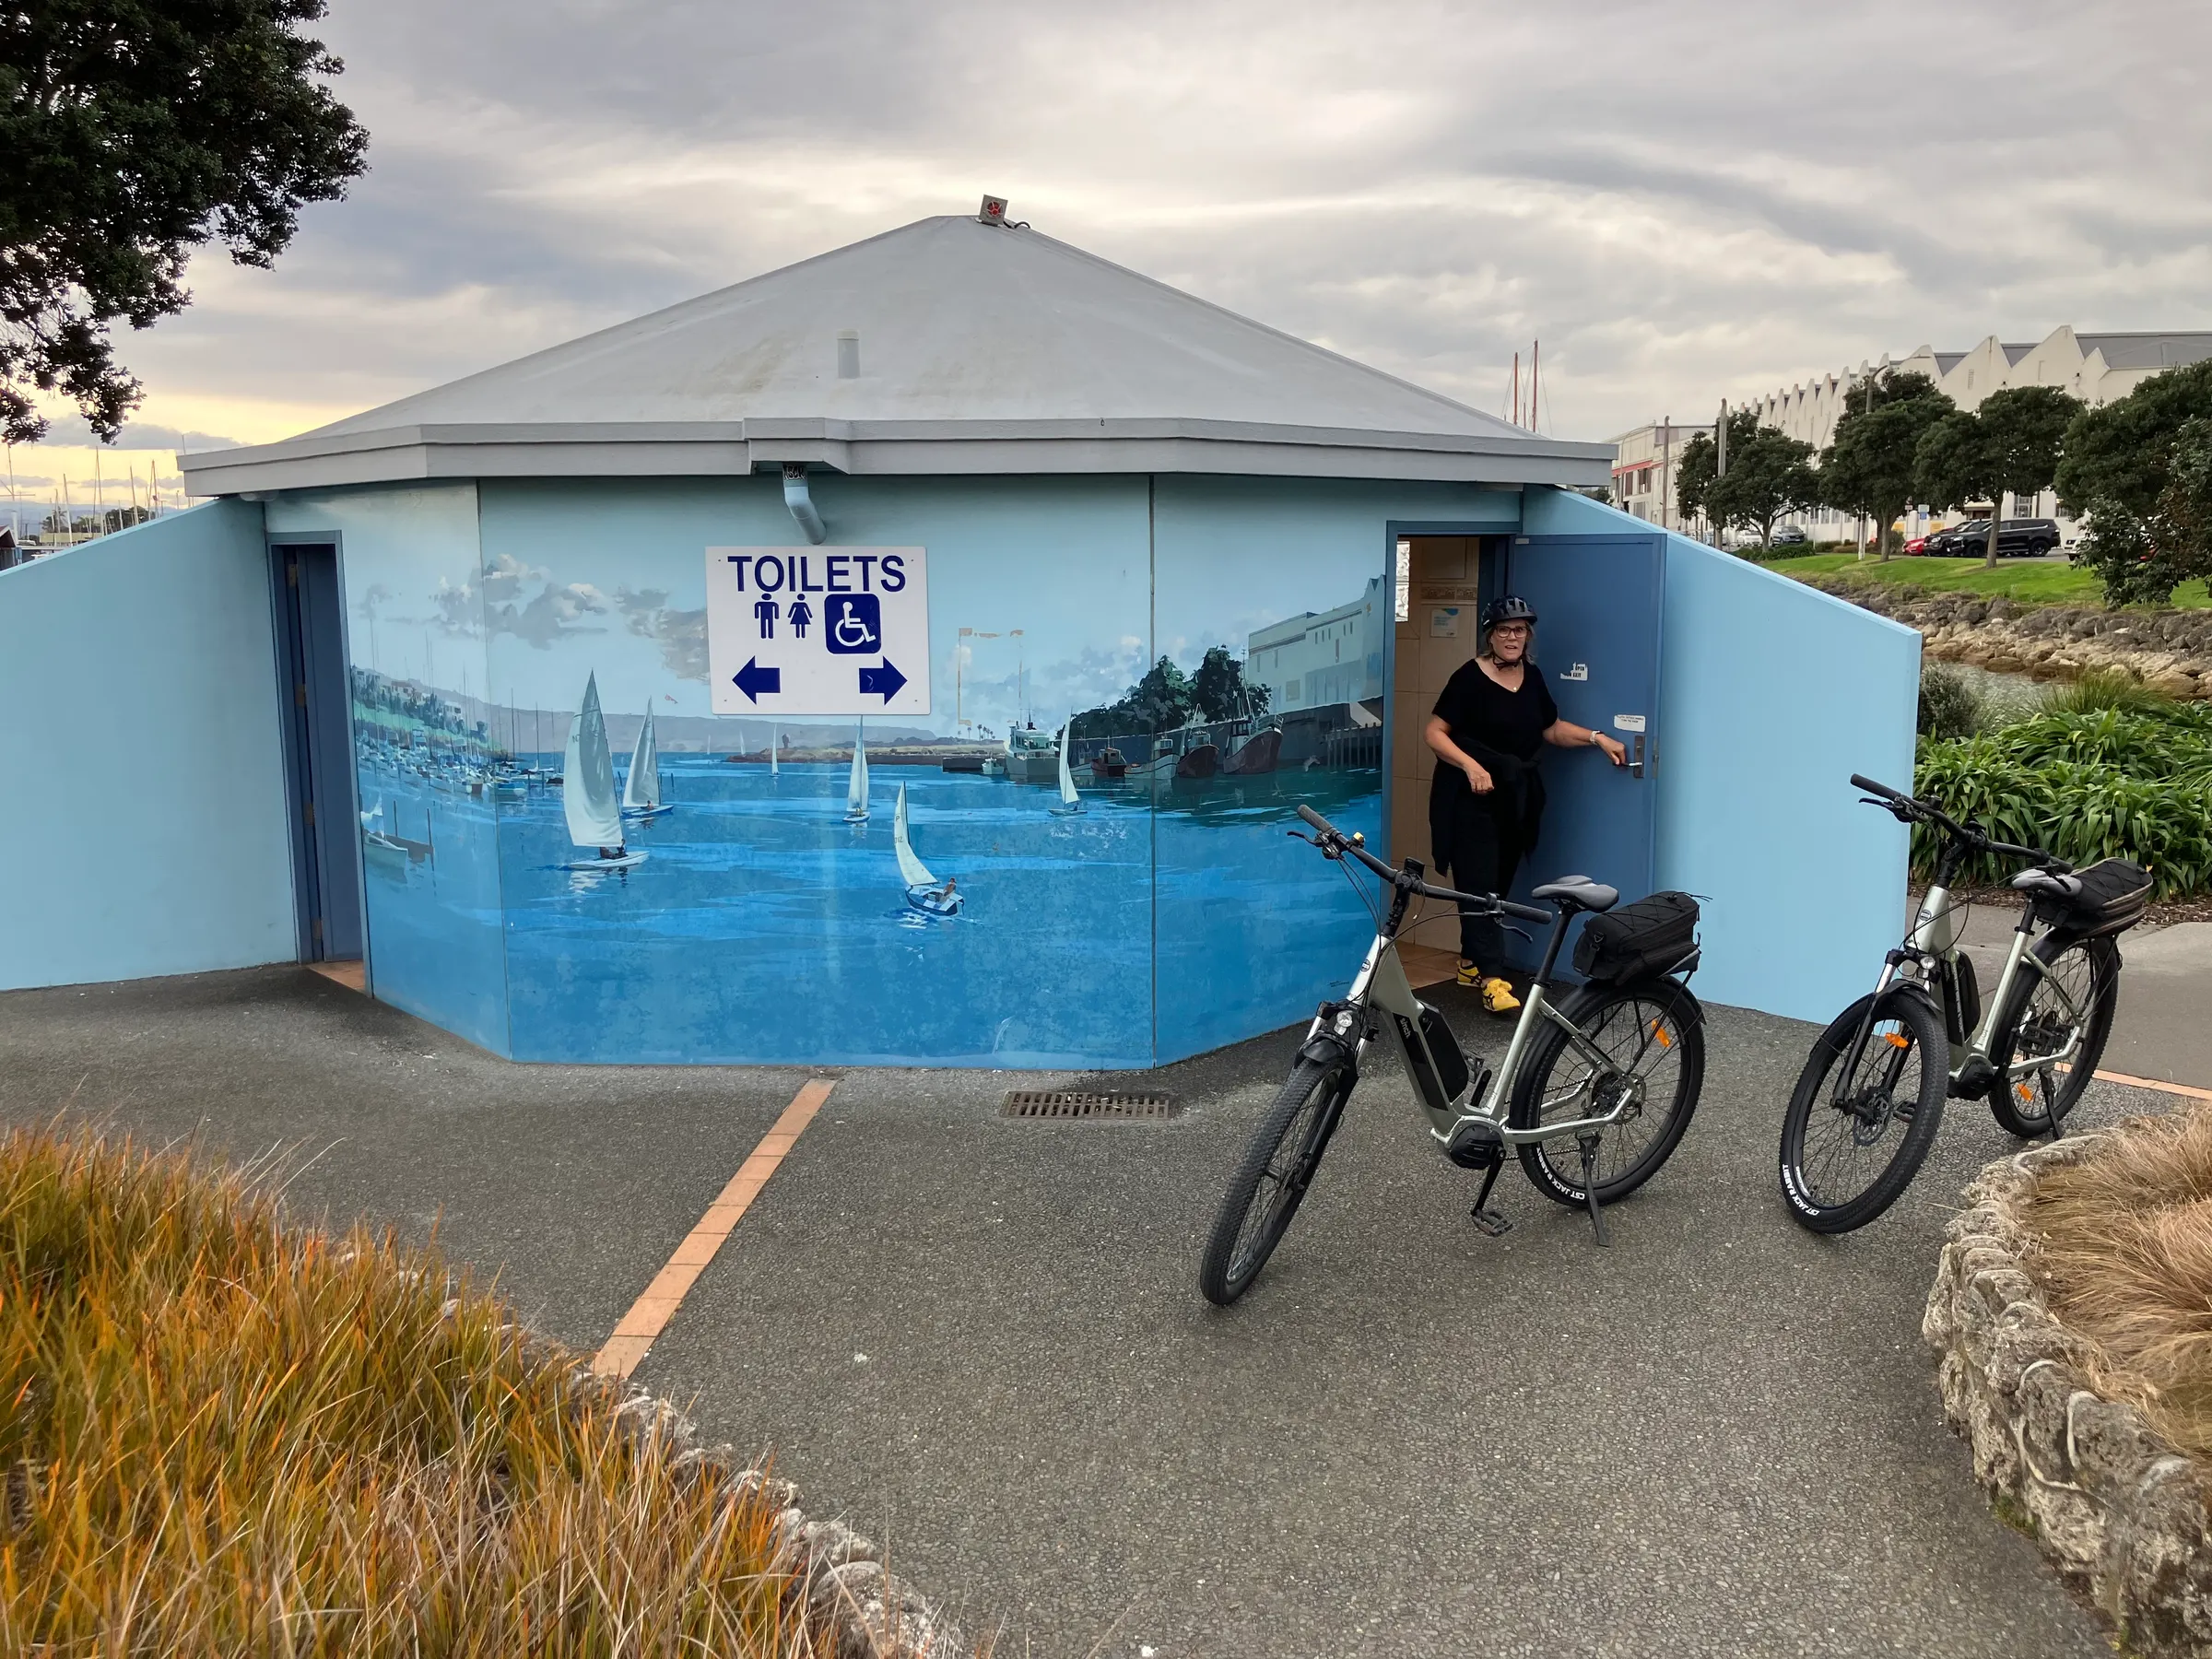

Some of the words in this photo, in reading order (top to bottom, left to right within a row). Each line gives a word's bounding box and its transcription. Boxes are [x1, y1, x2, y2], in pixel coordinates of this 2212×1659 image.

[727, 555, 906, 593] TOILETS
[1536, 1147, 1553, 1181] RABBIT
[1552, 1178, 1571, 1195] JACK
[1782, 1163, 1797, 1196] RABBIT
[1571, 1191, 1585, 1200] CST
[1792, 1194, 1809, 1210] JACK
